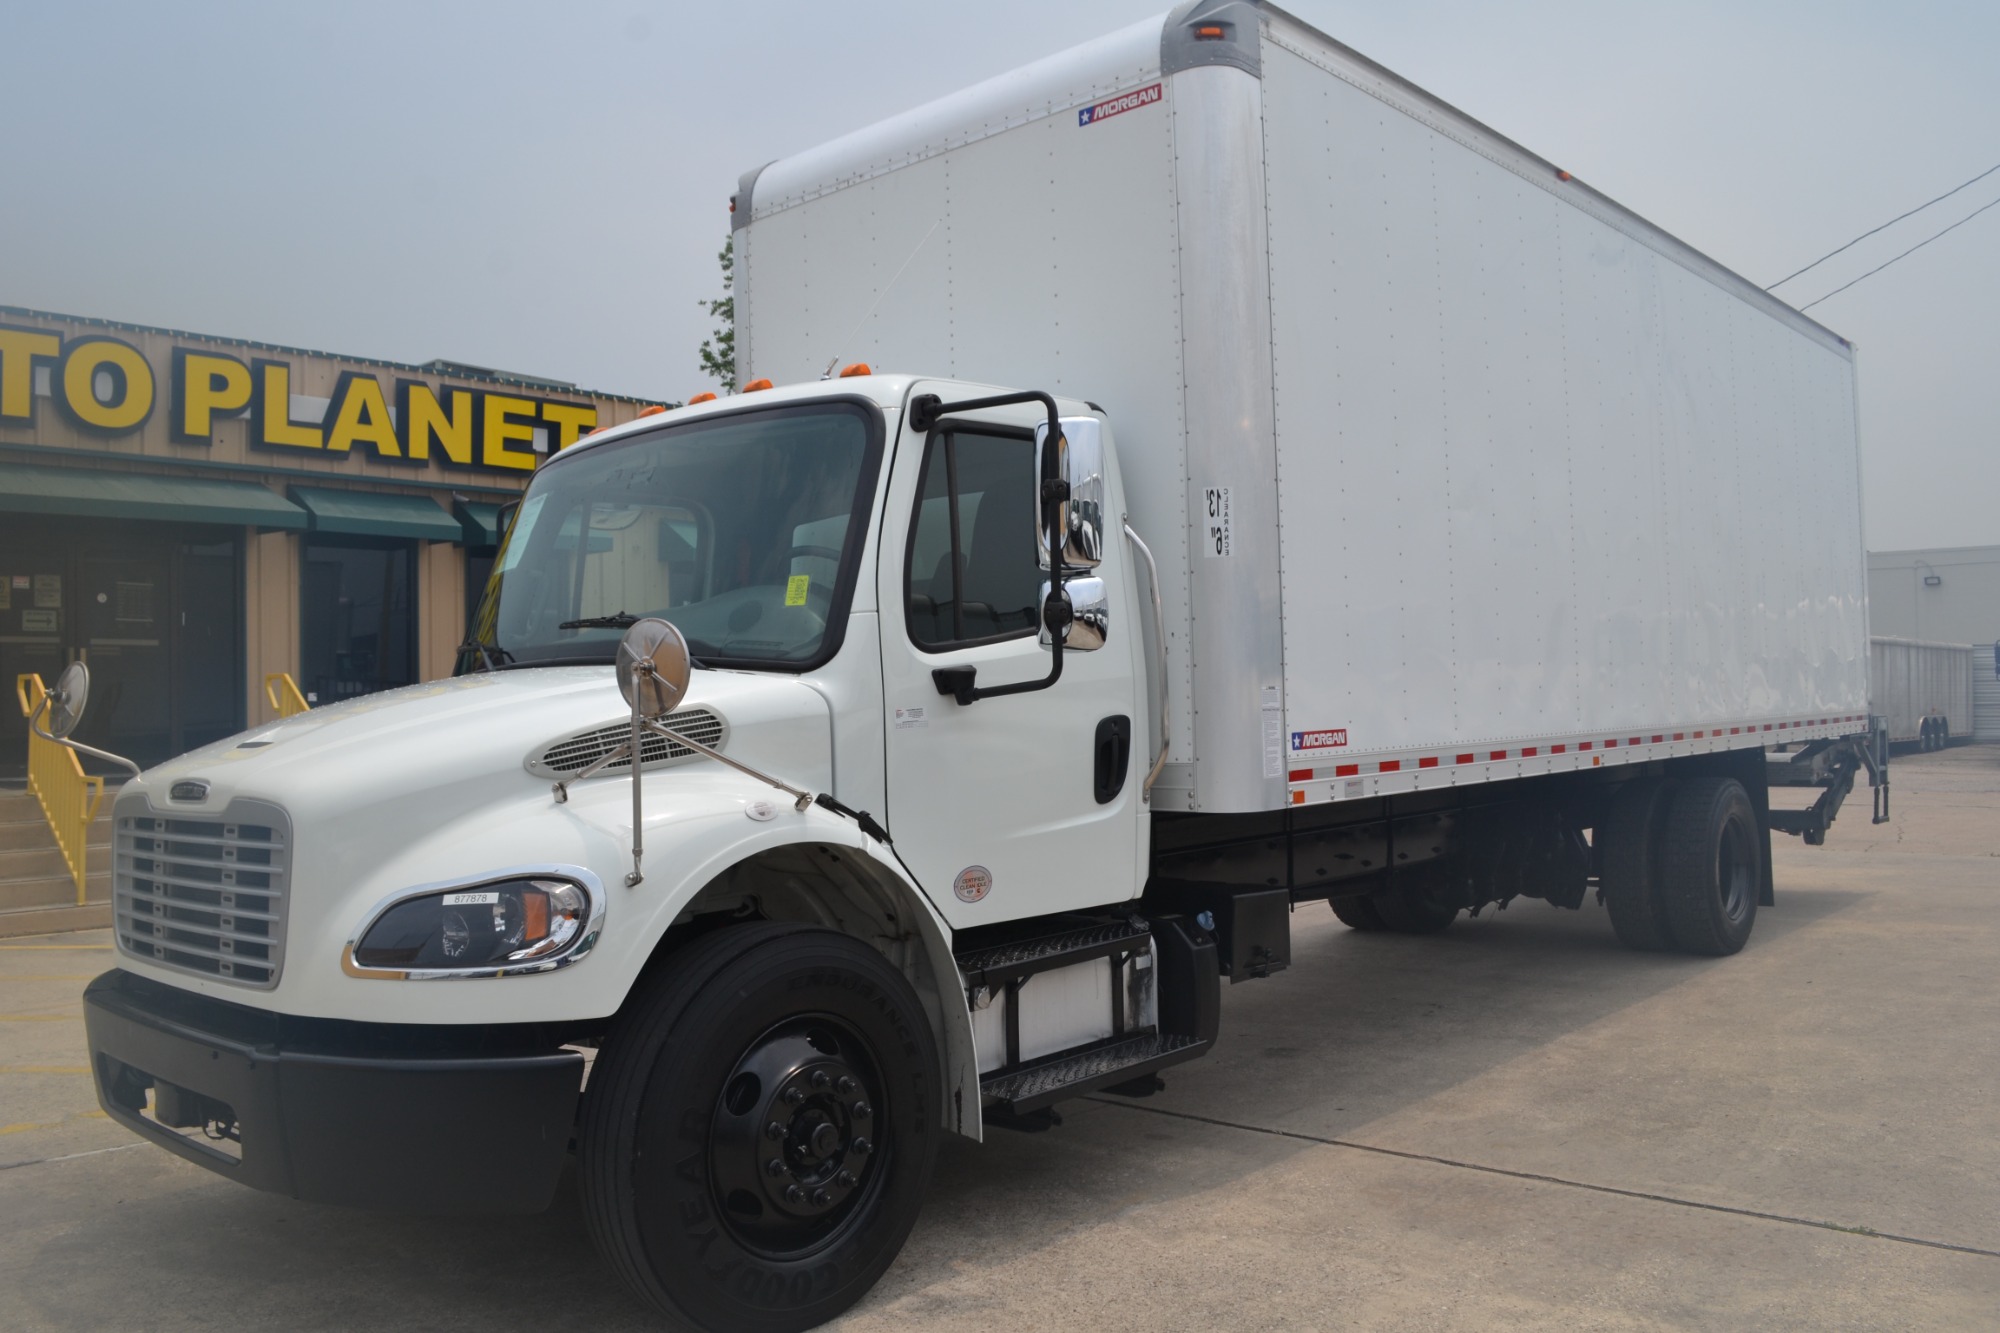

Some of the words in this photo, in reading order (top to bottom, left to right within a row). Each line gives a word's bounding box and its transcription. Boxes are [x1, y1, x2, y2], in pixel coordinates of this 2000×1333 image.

[1093, 88, 1159, 119] MORGAN
[184, 354, 597, 470] PLANET
[1303, 732, 1345, 747] MORGAN
[962, 876, 985, 884] CERTIFIED
[454, 894, 487, 903] 877878
[787, 974, 918, 1058] ENDURANCE
[675, 1107, 840, 1305] GOODYEAR
